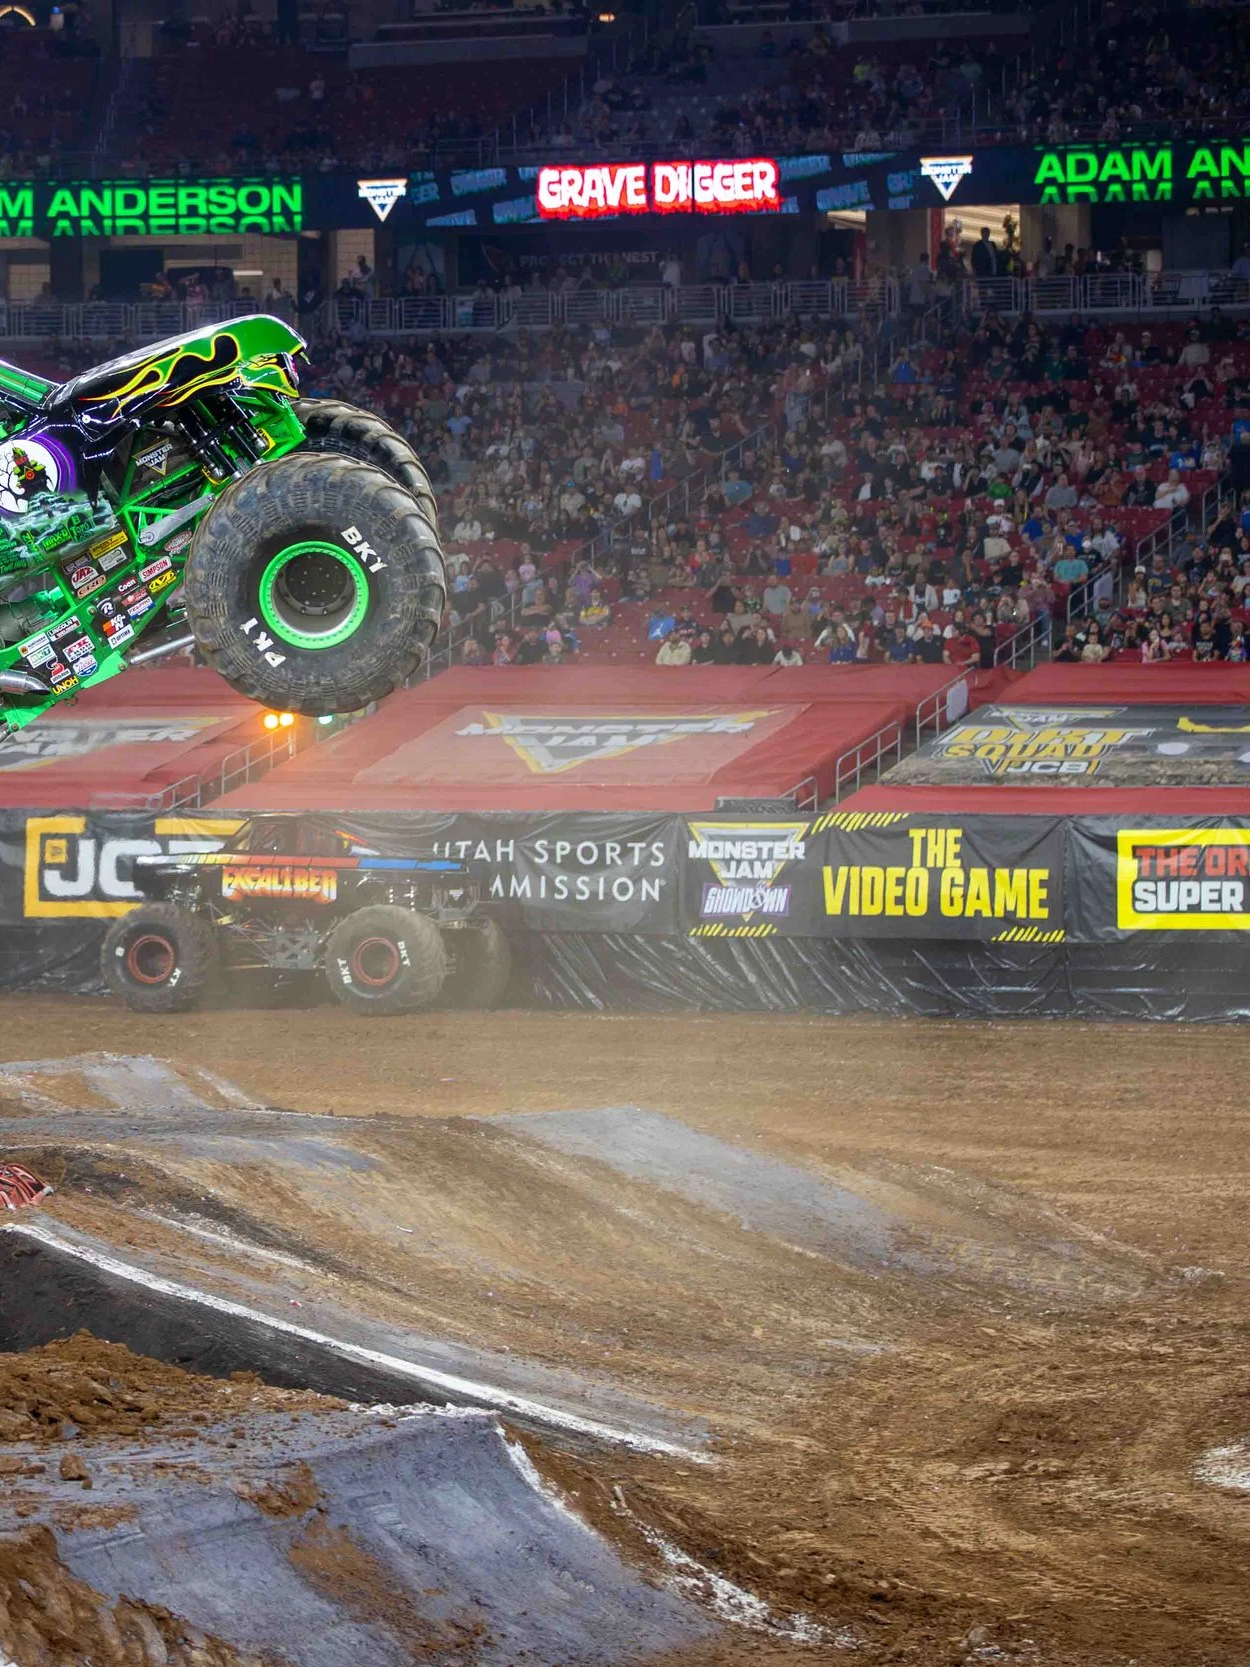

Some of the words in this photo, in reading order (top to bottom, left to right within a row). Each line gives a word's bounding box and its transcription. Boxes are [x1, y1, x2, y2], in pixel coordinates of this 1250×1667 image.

[1034, 148, 1173, 184] ADAM
[537, 165, 648, 214] GRAVE
[654, 160, 779, 210] DIGGER
[47, 184, 303, 218] ANDERSON
[135, 443, 174, 467] MONSTER
[150, 453, 167, 467] JAM
[72, 566, 94, 584] JAZ
[142, 559, 169, 580] SIMPSON
[118, 579, 137, 592] Coan
[48, 618, 74, 638] LINCOLN
[52, 676, 79, 696] UNOH
[454, 717, 755, 736] MONSTER
[540, 733, 662, 747] JAM
[943, 743, 1108, 763] SQUAD
[1006, 760, 1090, 774] JCB
[533, 839, 666, 868] SPORTS
[688, 839, 806, 860] MONSTER
[908, 828, 963, 868] THE
[720, 859, 775, 880] JAM
[1135, 847, 1198, 877] THE
[1205, 847, 1250, 877] OR
[221, 865, 338, 901] EXCALIBER
[822, 865, 929, 917] VIDEO
[939, 867, 1050, 919] GAME
[702, 885, 790, 915] SHOWDOWN
[1134, 880, 1244, 912] SUPER
